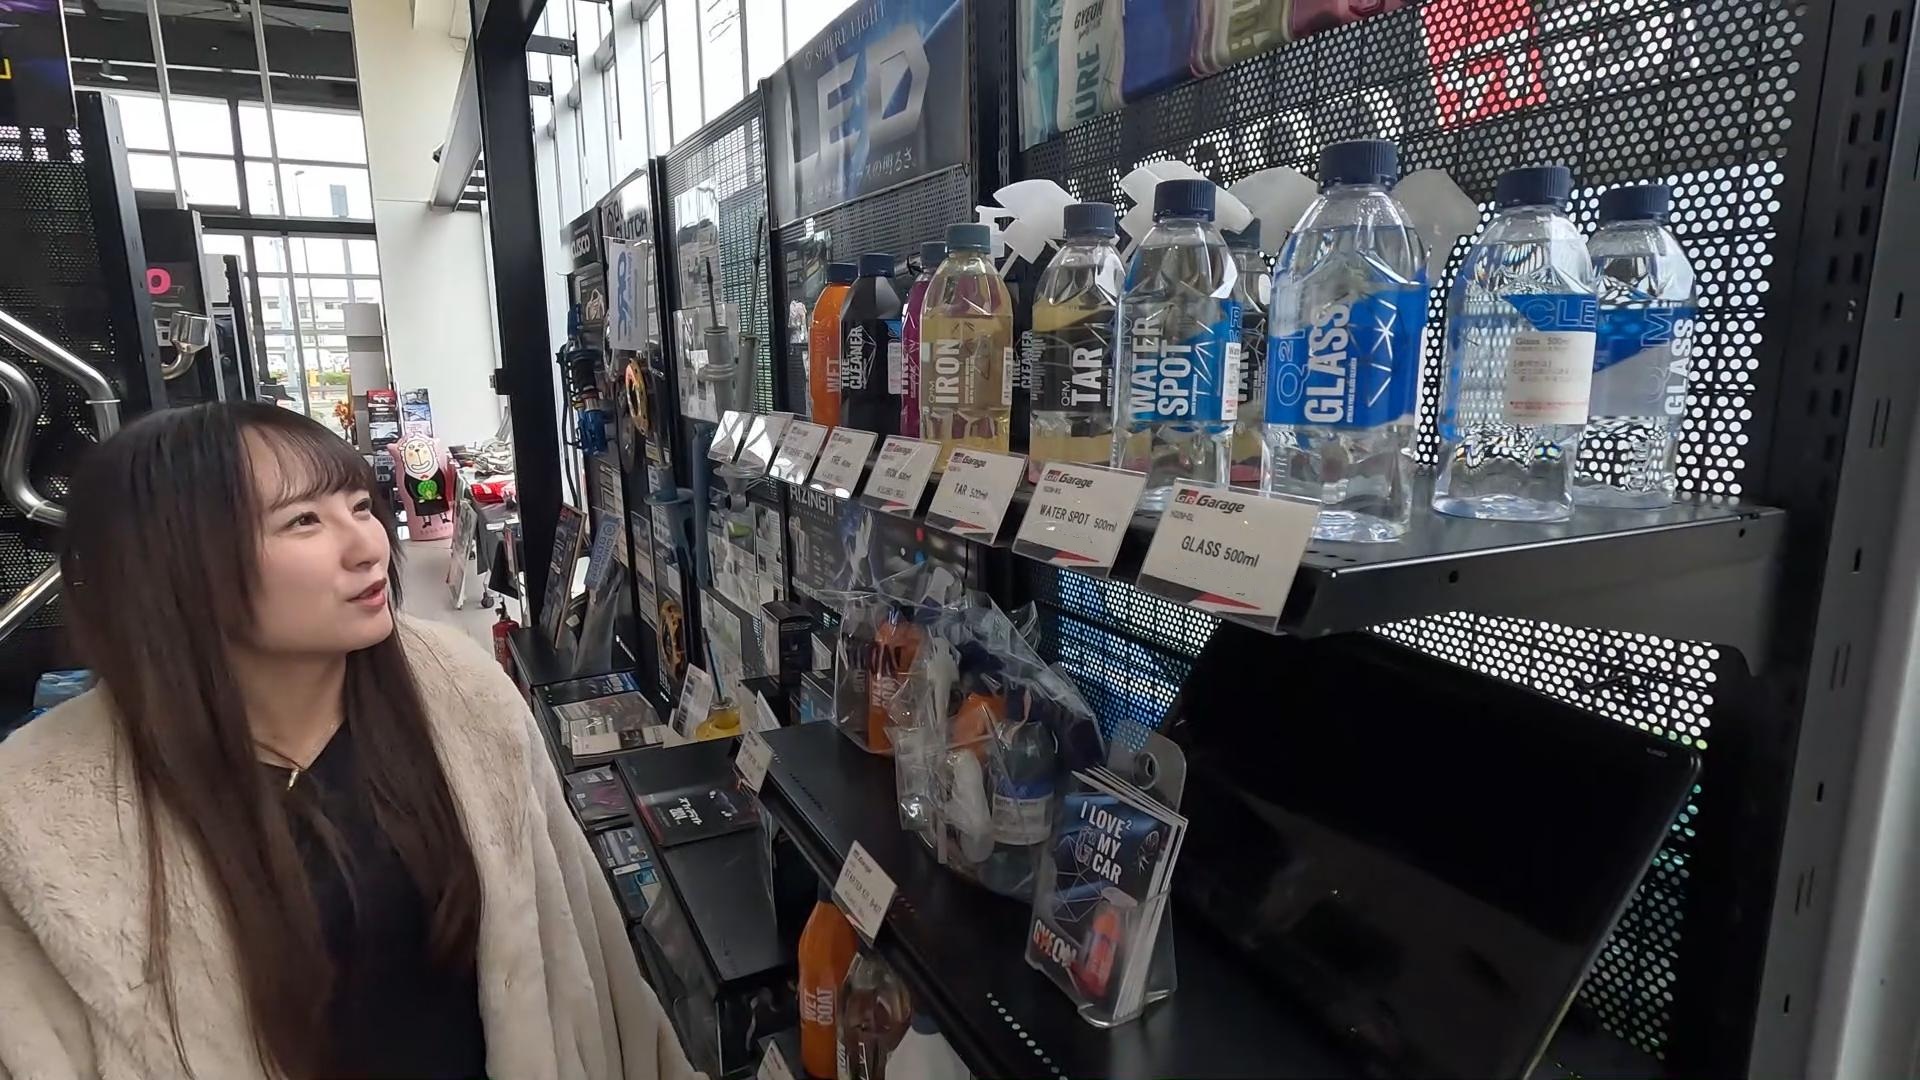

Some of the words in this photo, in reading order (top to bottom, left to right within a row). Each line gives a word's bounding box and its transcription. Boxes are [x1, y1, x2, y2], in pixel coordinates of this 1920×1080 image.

[1074, 0, 1105, 29] GYEON
[783, 22, 931, 167] LED
[841, 358, 850, 390] TIRE
[849, 325, 863, 390] CLEANER
[936, 338, 960, 405] IRON
[1130, 317, 1162, 414] WATER
[1276, 328, 1311, 407] Q²
[1303, 303, 1352, 424] GLASS
[1663, 318, 1694, 417] GLASS
[1071, 346, 1103, 407] TAR
[1158, 338, 1192, 417] SPOT
[789, 483, 826, 512] RIZING
[953, 482, 968, 496] TAR
[1058, 473, 1095, 489] Garage
[1038, 503, 1068, 522] WATER
[1067, 509, 1090, 526] SPOT
[1093, 516, 1118, 533] 500ml
[1196, 494, 1246, 514] Garage
[1180, 534, 1223, 559] GLASS
[1223, 543, 1261, 569] 500ml
[1080, 800, 1088, 819] I
[1097, 833, 1122, 858] MY
[1092, 855, 1123, 885] CAR
[803, 987, 817, 1022] WET
[816, 985, 834, 1026] COAT
